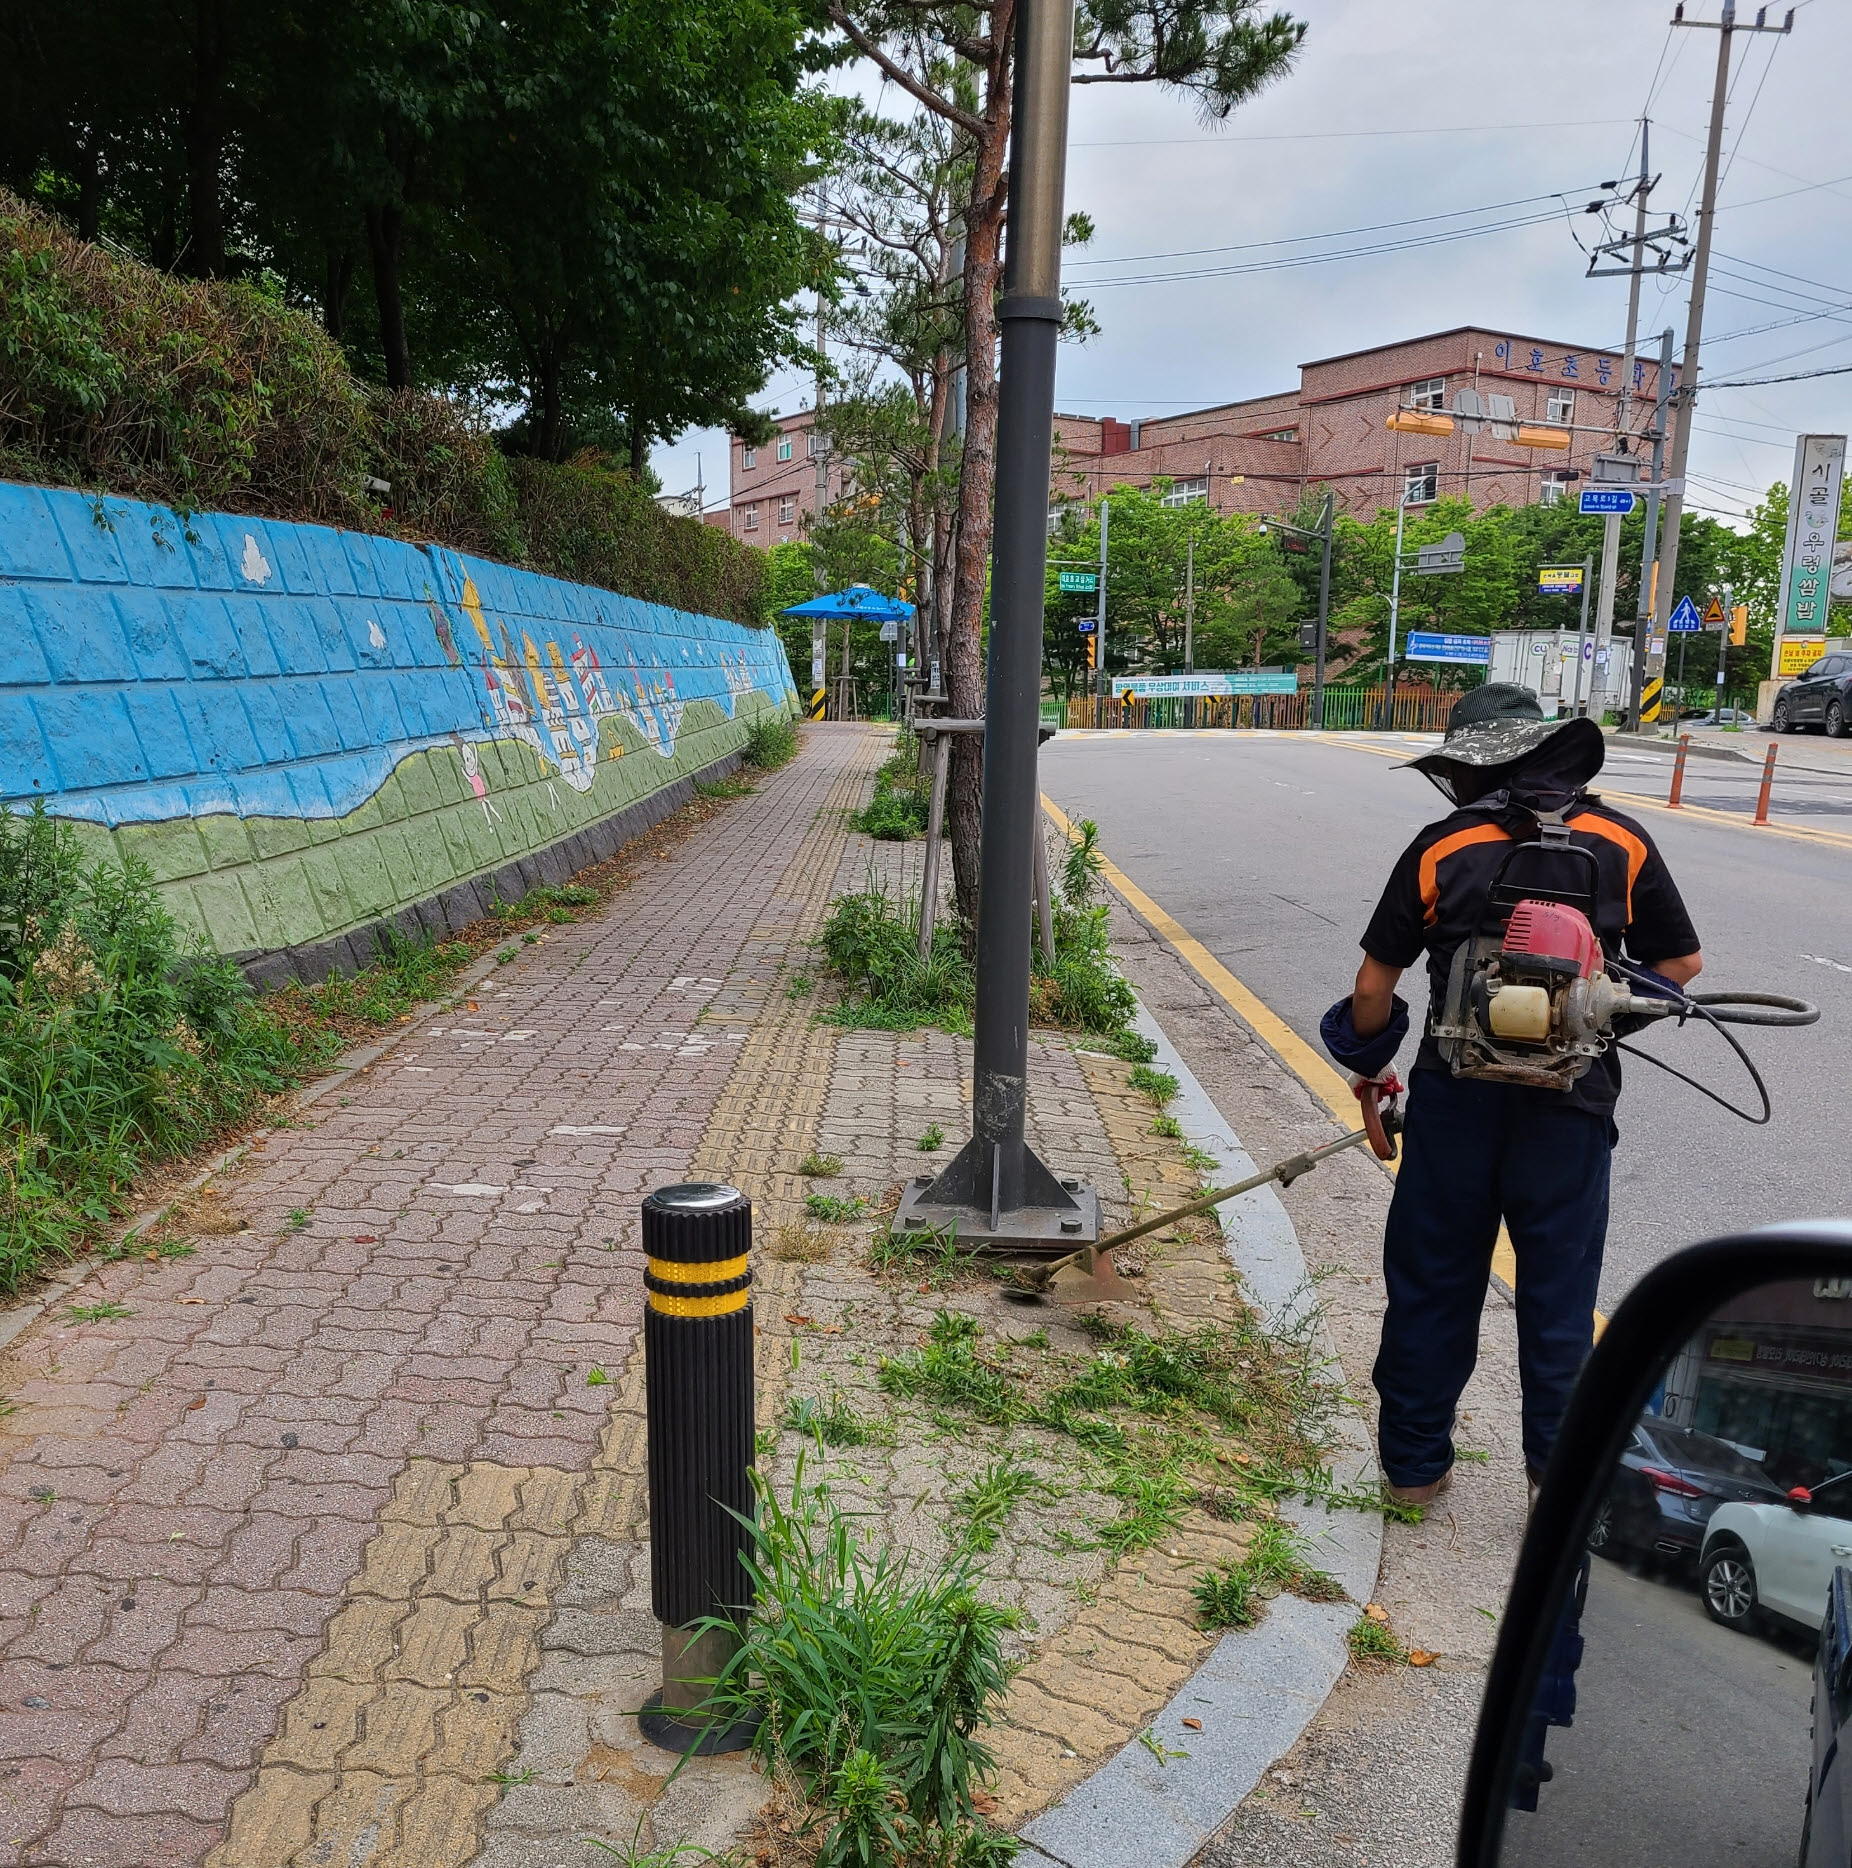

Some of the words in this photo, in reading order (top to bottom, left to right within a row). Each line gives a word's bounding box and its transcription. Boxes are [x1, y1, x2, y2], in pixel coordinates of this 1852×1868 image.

[1495, 340, 1677, 393] 이호초등학
[1809, 463, 1831, 506] 시골
[1182, 680, 1210, 691] 서비스
